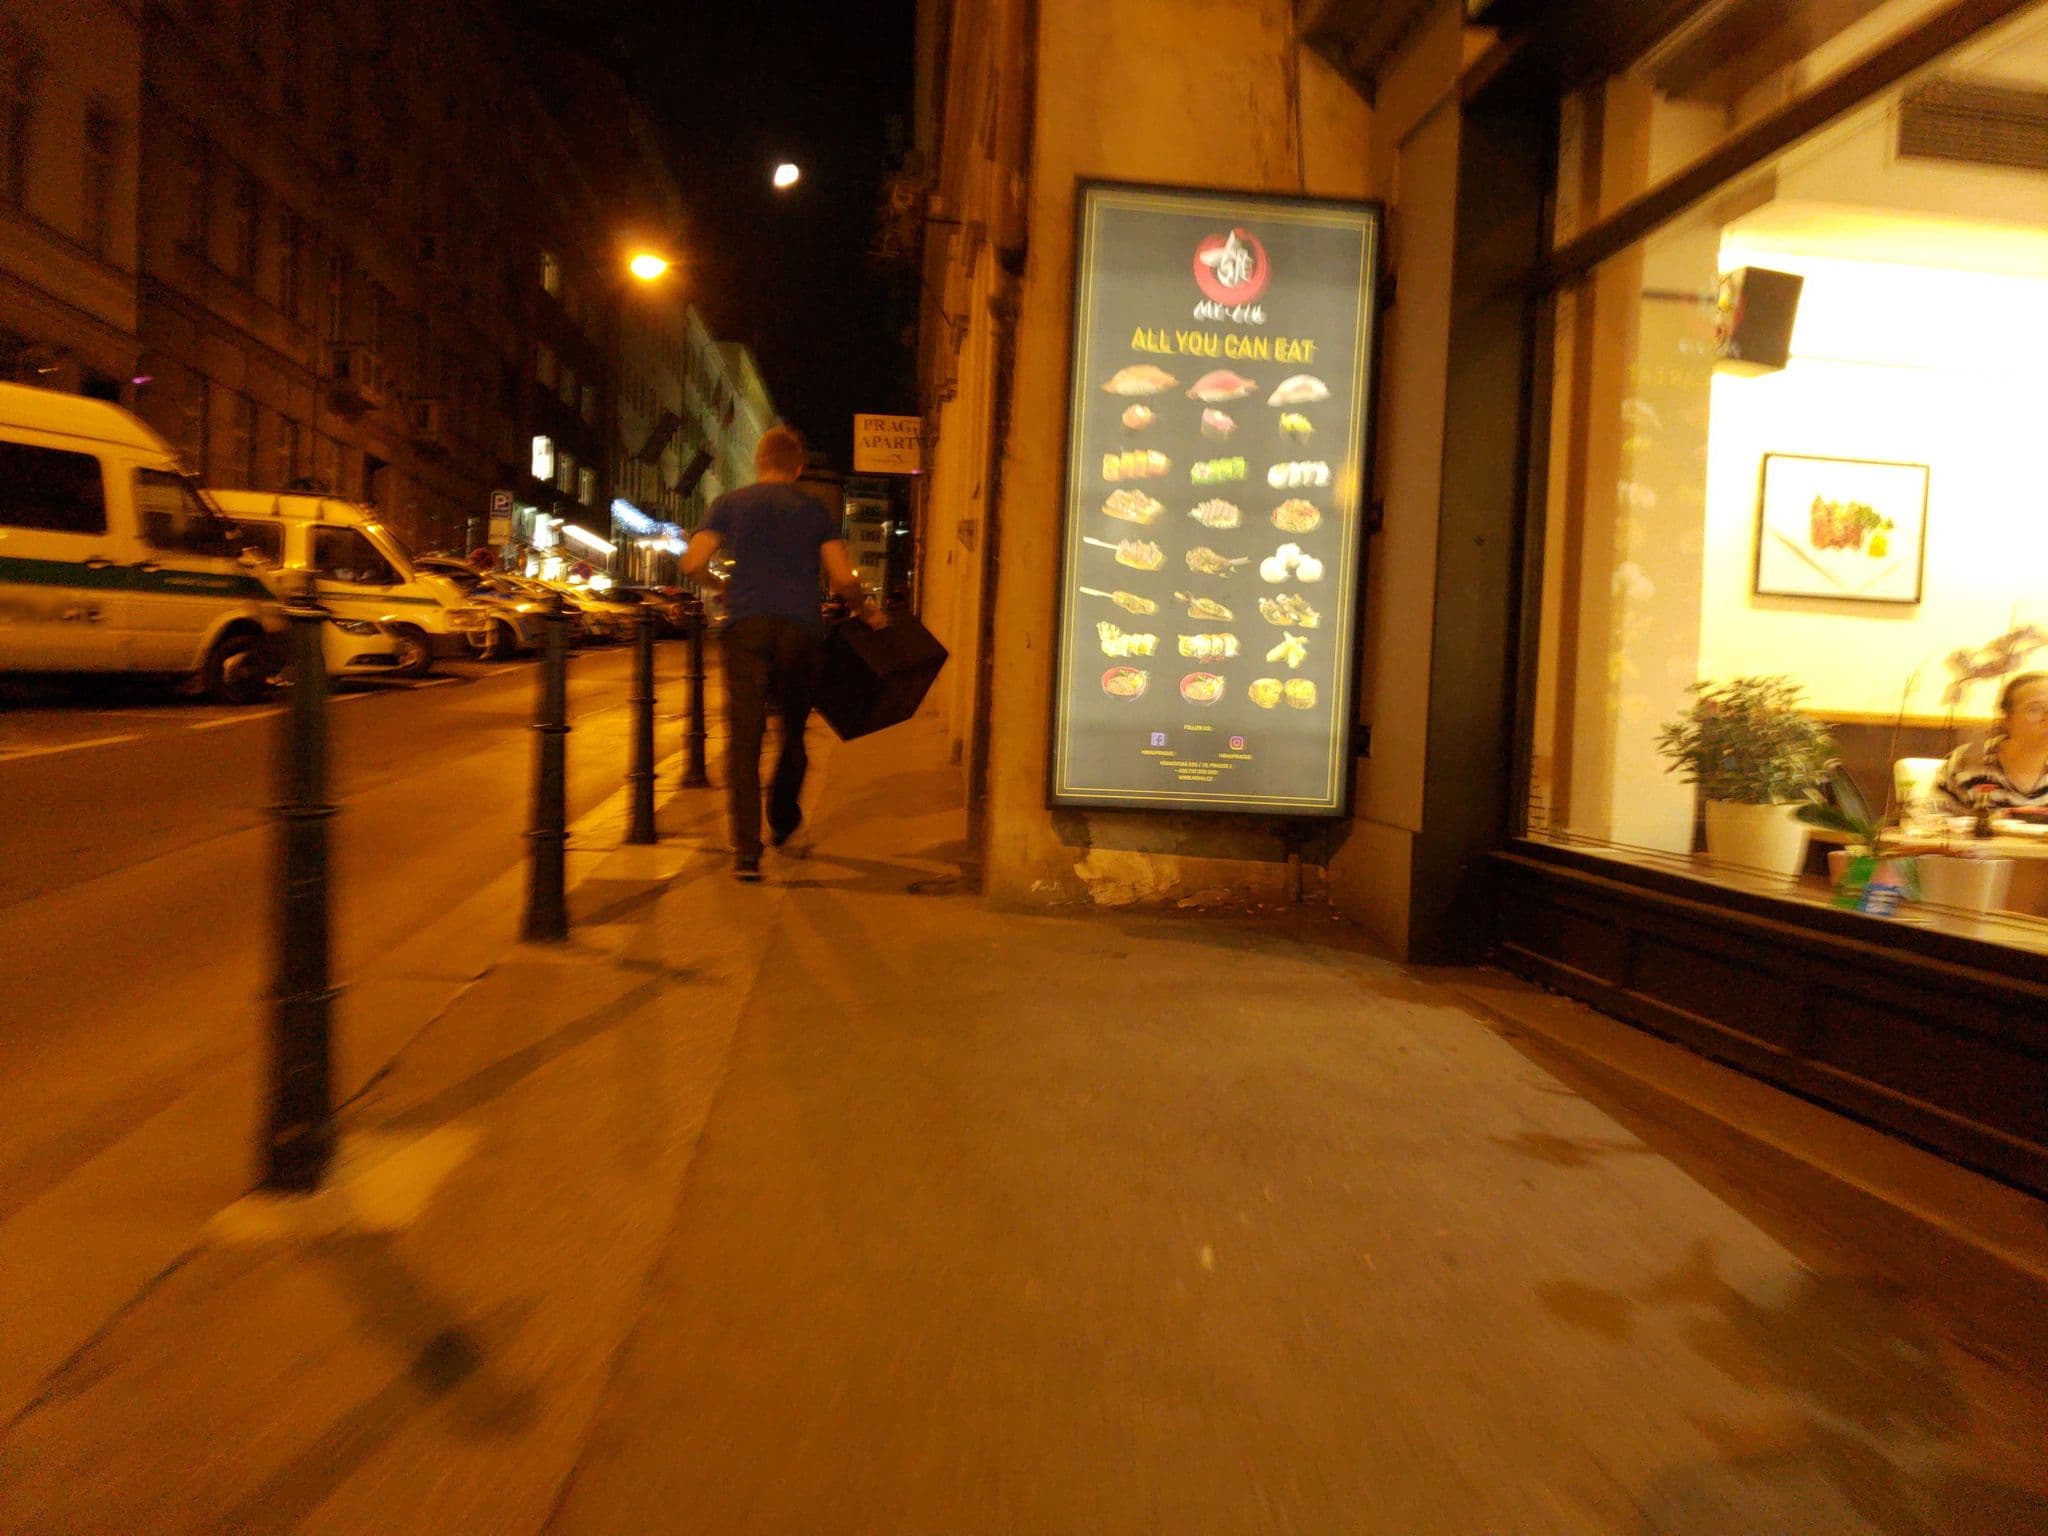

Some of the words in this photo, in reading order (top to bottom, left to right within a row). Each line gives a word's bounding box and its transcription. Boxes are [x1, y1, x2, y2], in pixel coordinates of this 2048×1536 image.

[1131, 326, 1173, 354] ALL
[1176, 330, 1218, 357] YOU
[1224, 333, 1269, 360] CAN
[1274, 337, 1315, 363] EAT
